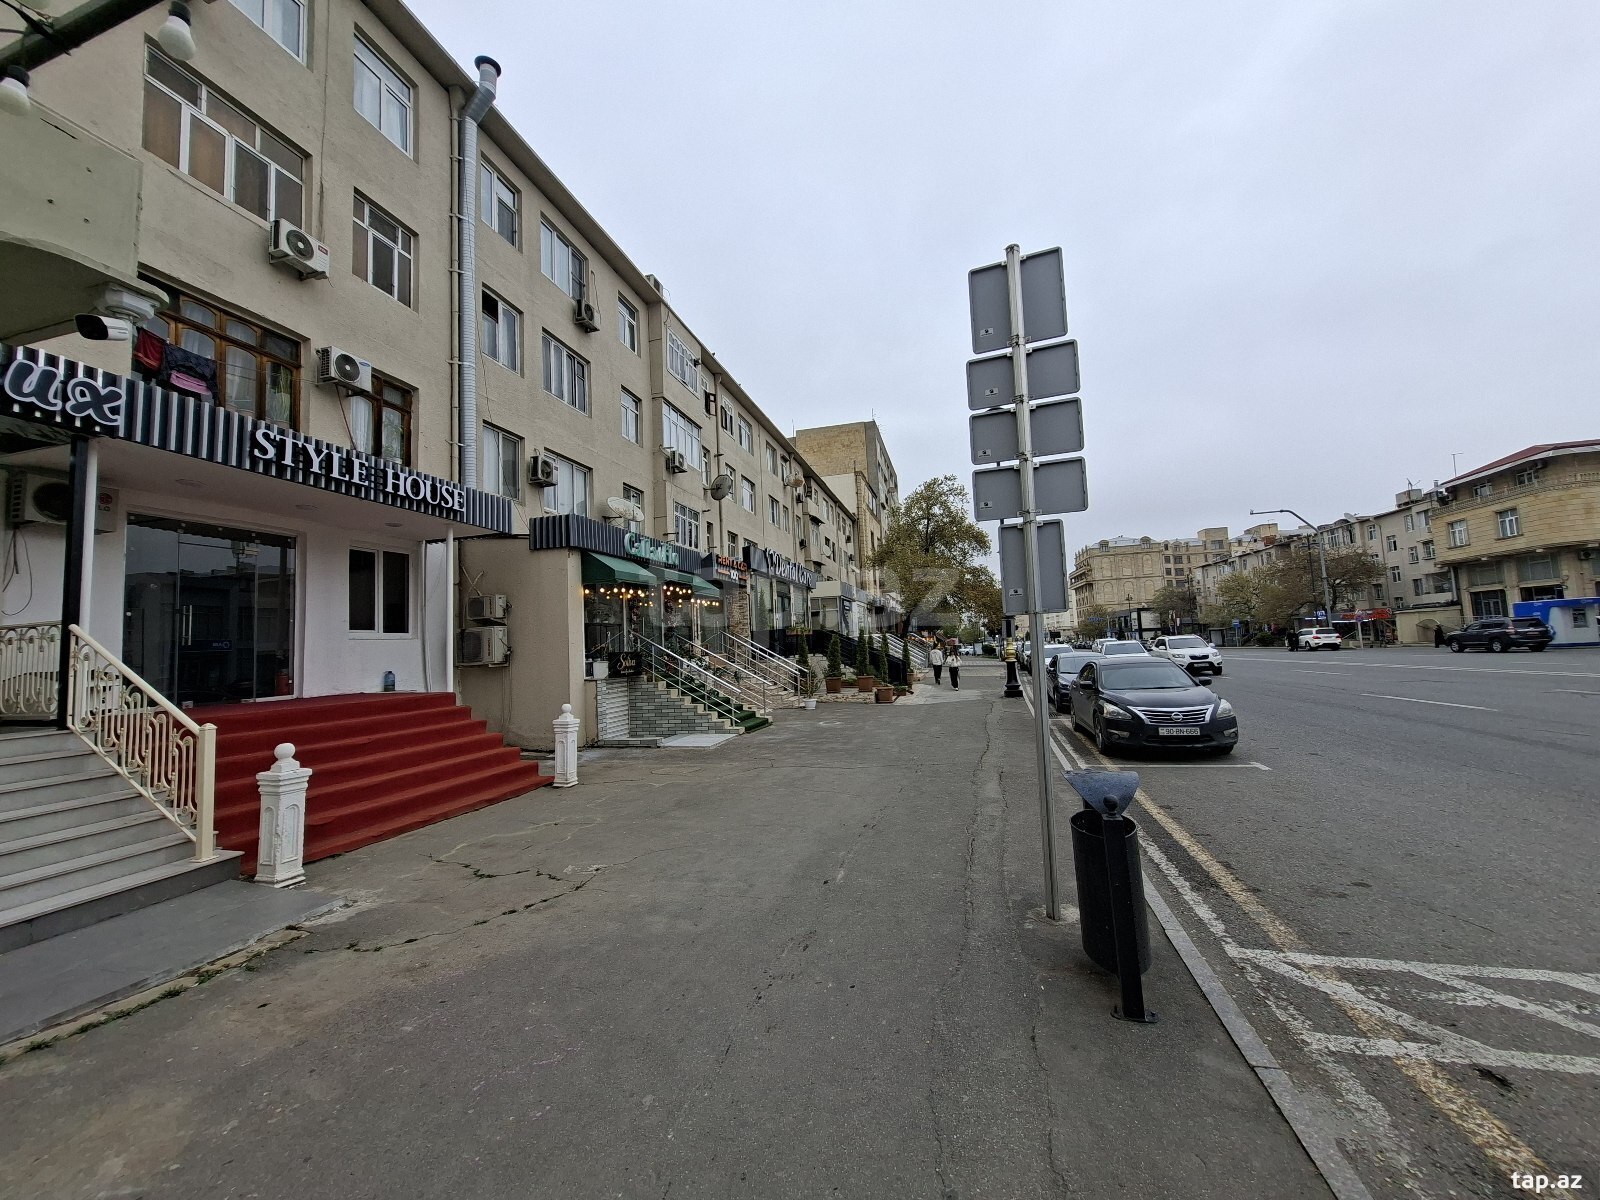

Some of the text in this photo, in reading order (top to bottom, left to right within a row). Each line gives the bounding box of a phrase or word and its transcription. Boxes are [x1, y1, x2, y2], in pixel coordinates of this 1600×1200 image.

[254, 429, 369, 486] STYLE
[385, 467, 465, 512] HOUSE
[775, 552, 812, 587] Dental Care
